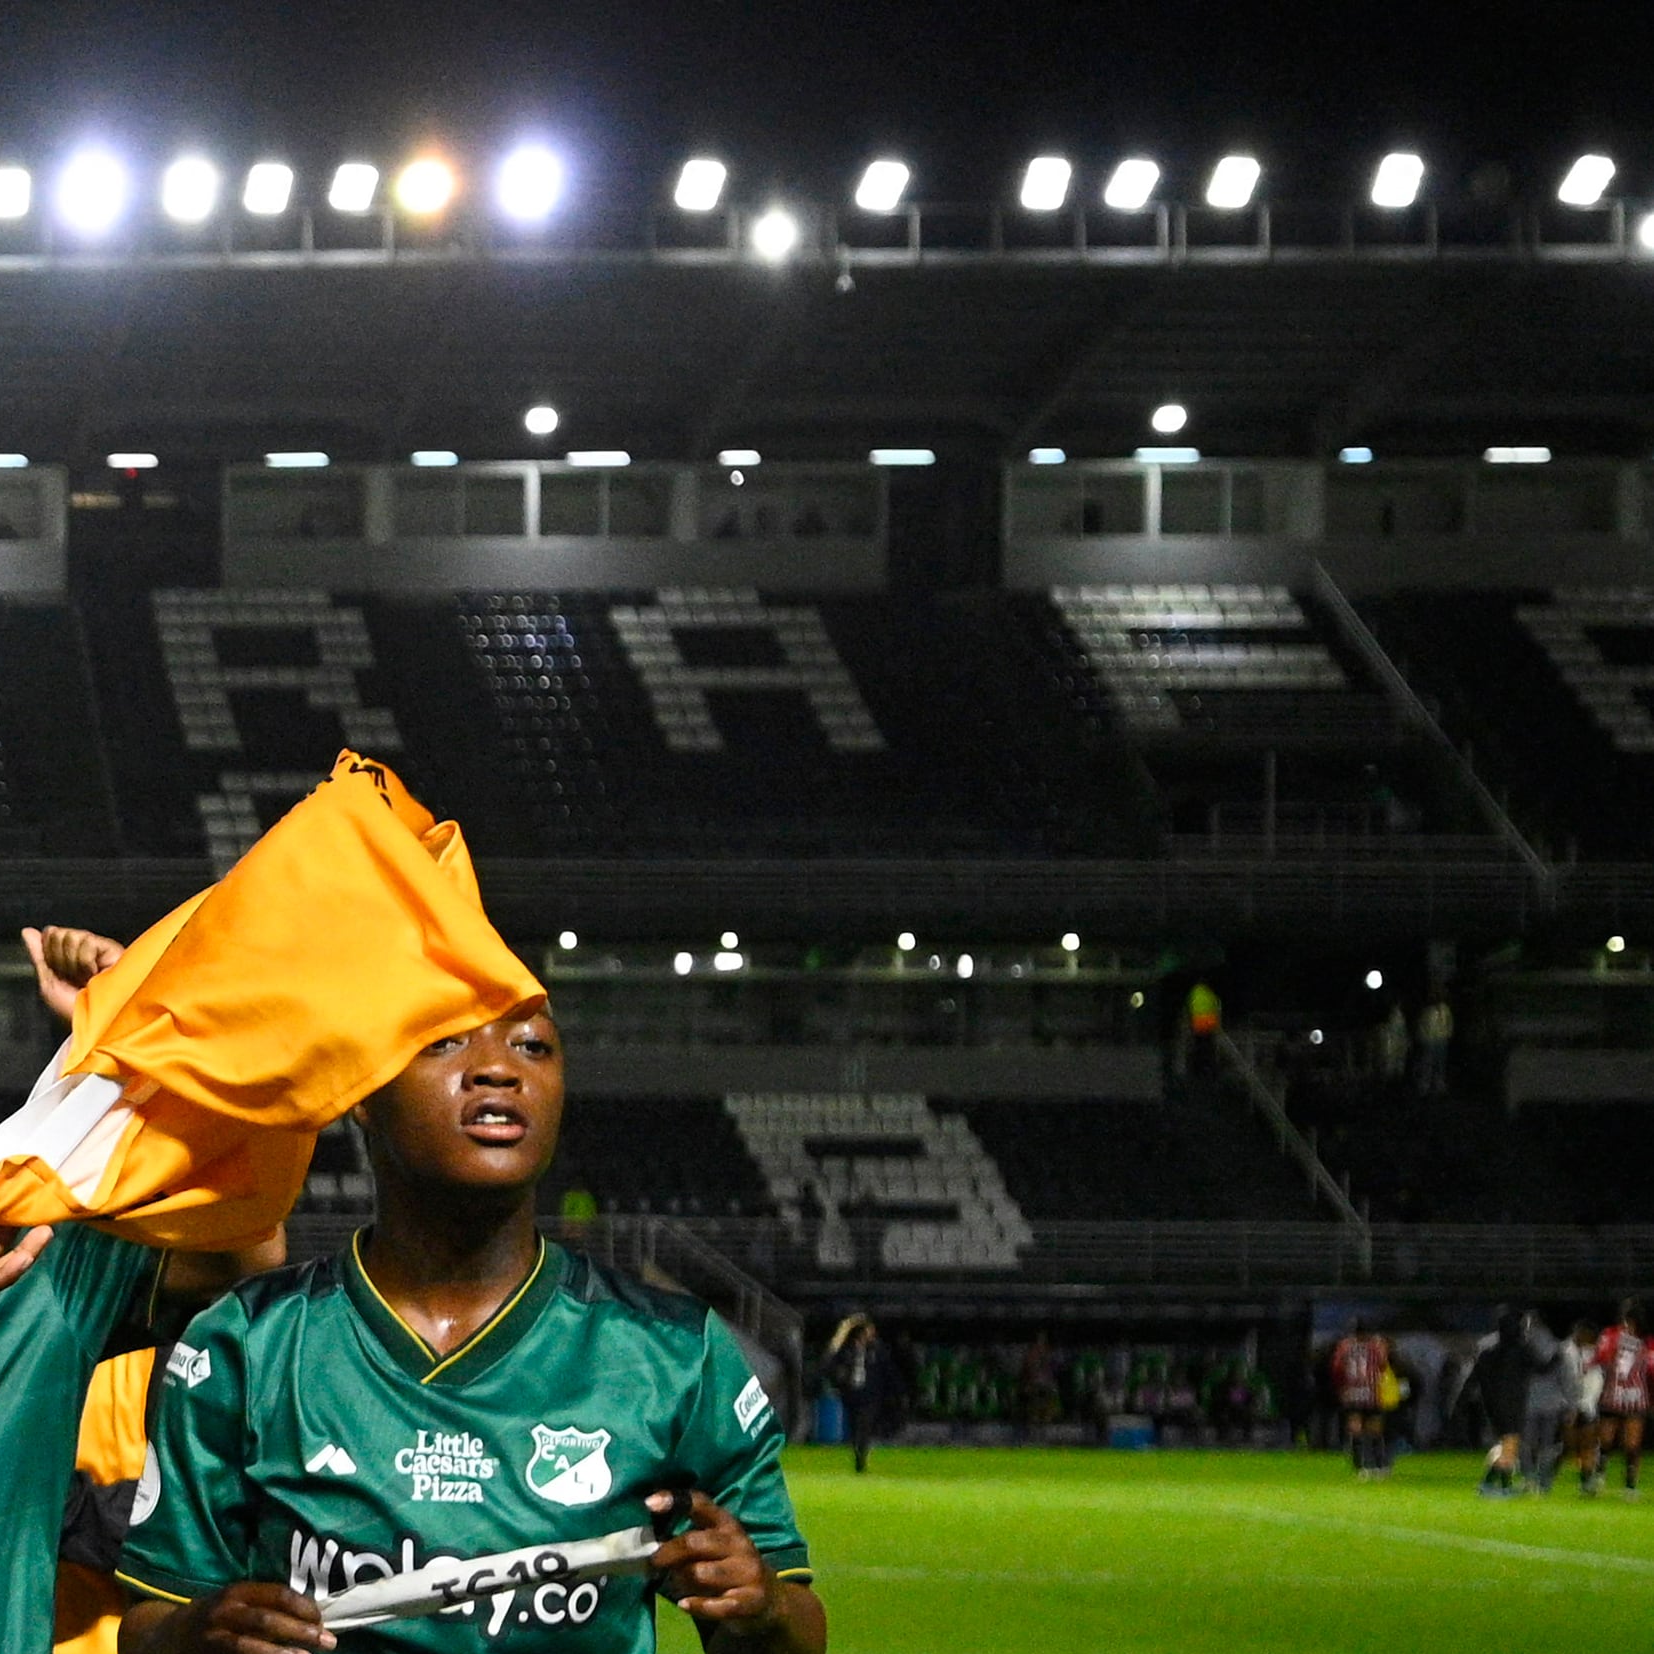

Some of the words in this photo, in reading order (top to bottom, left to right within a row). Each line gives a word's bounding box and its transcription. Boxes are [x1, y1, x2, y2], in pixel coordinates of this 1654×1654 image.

[416, 1429, 484, 1458] Little
[542, 1435, 602, 1449] DEPORTIVO
[395, 1448, 495, 1479] Caesars
[412, 1474, 484, 1502] Pizza
